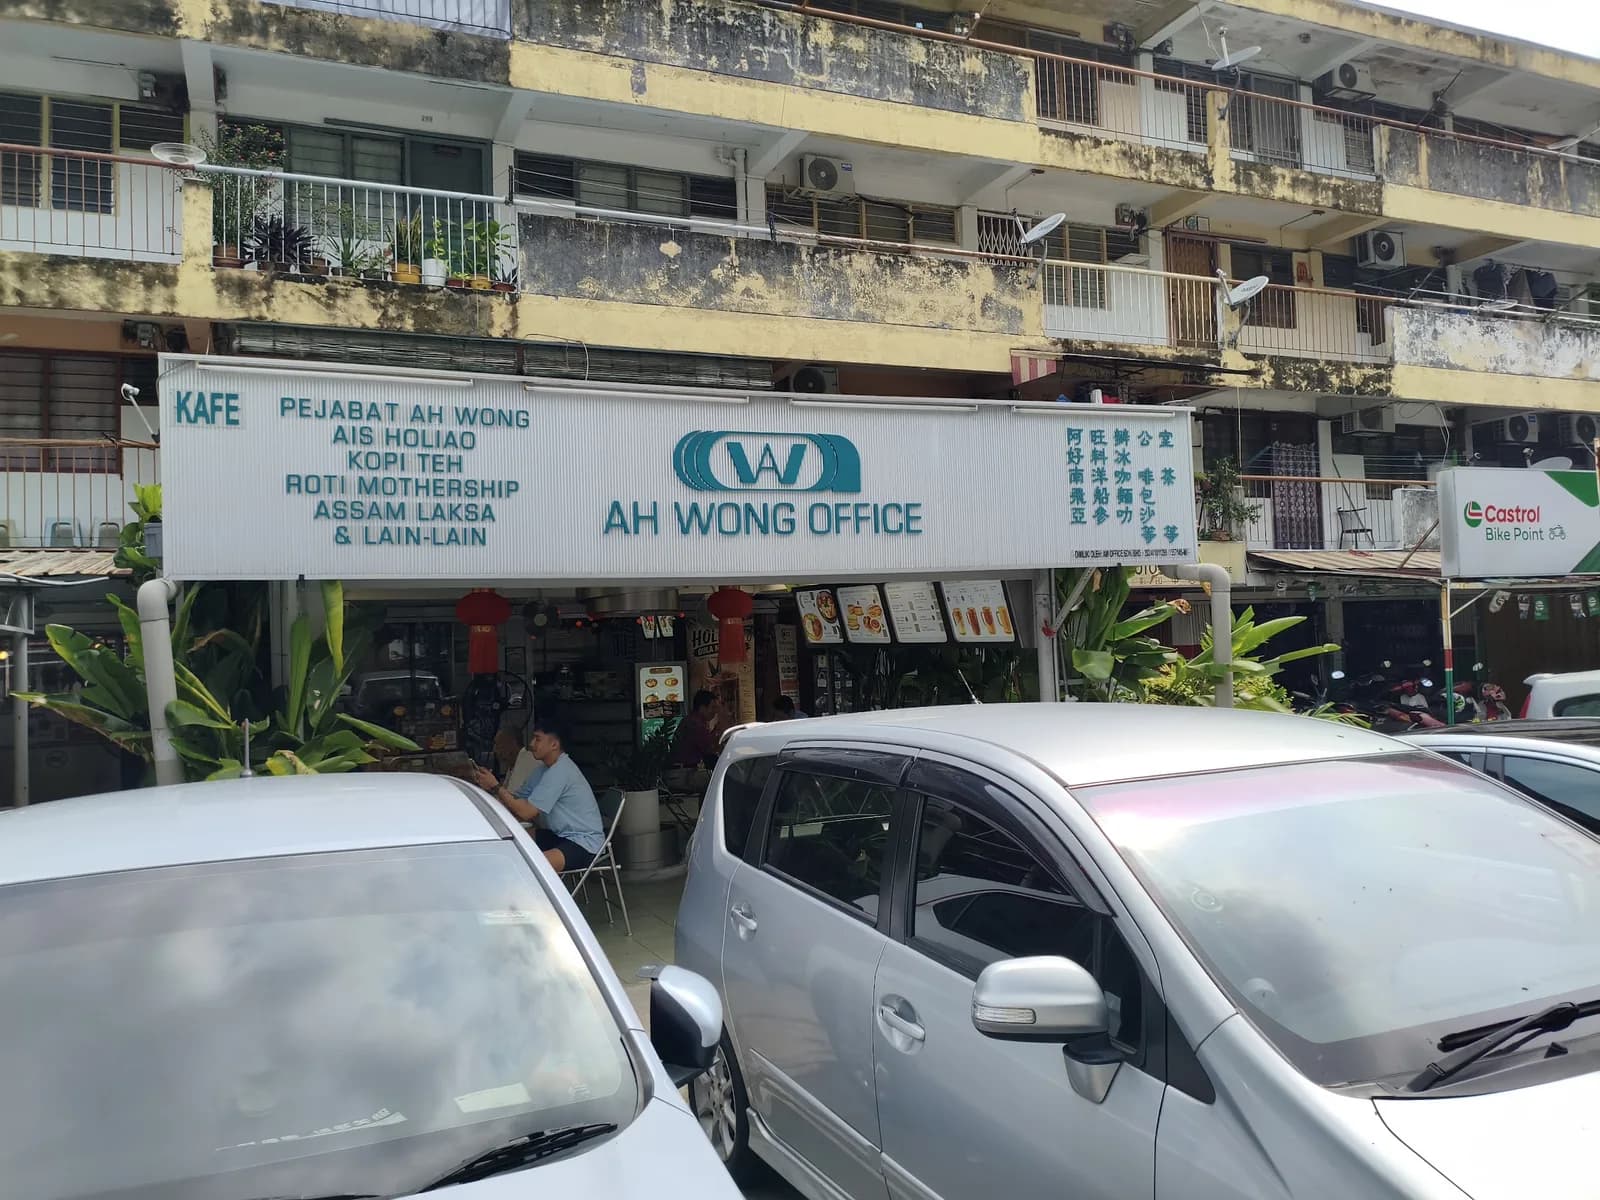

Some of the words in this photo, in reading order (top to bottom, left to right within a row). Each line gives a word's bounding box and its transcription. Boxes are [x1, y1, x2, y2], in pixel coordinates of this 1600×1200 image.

[176, 392, 239, 426] KAFE
[280, 397, 399, 421] PEJABAT
[410, 404, 443, 424] AH
[455, 407, 530, 428] WONG
[333, 425, 373, 445] AIS
[385, 428, 476, 450] HOLIAO
[348, 450, 406, 471] KOPI
[418, 453, 463, 473] TEH
[1066, 446, 1132, 466] 好料冰
[286, 474, 346, 494] ROTI
[358, 476, 520, 499] MOTHERSHIP
[314, 500, 406, 521] ASSAM
[418, 502, 496, 522] LAKSA
[604, 500, 660, 535] AH
[672, 502, 797, 536] WONG
[808, 502, 923, 536] OFFICE
[1484, 505, 1540, 523] Castrol
[334, 526, 352, 545] &
[364, 526, 487, 547] LAIN-LAIN
[1485, 527, 1511, 541] Bike
[1513, 527, 1544, 541] Point
